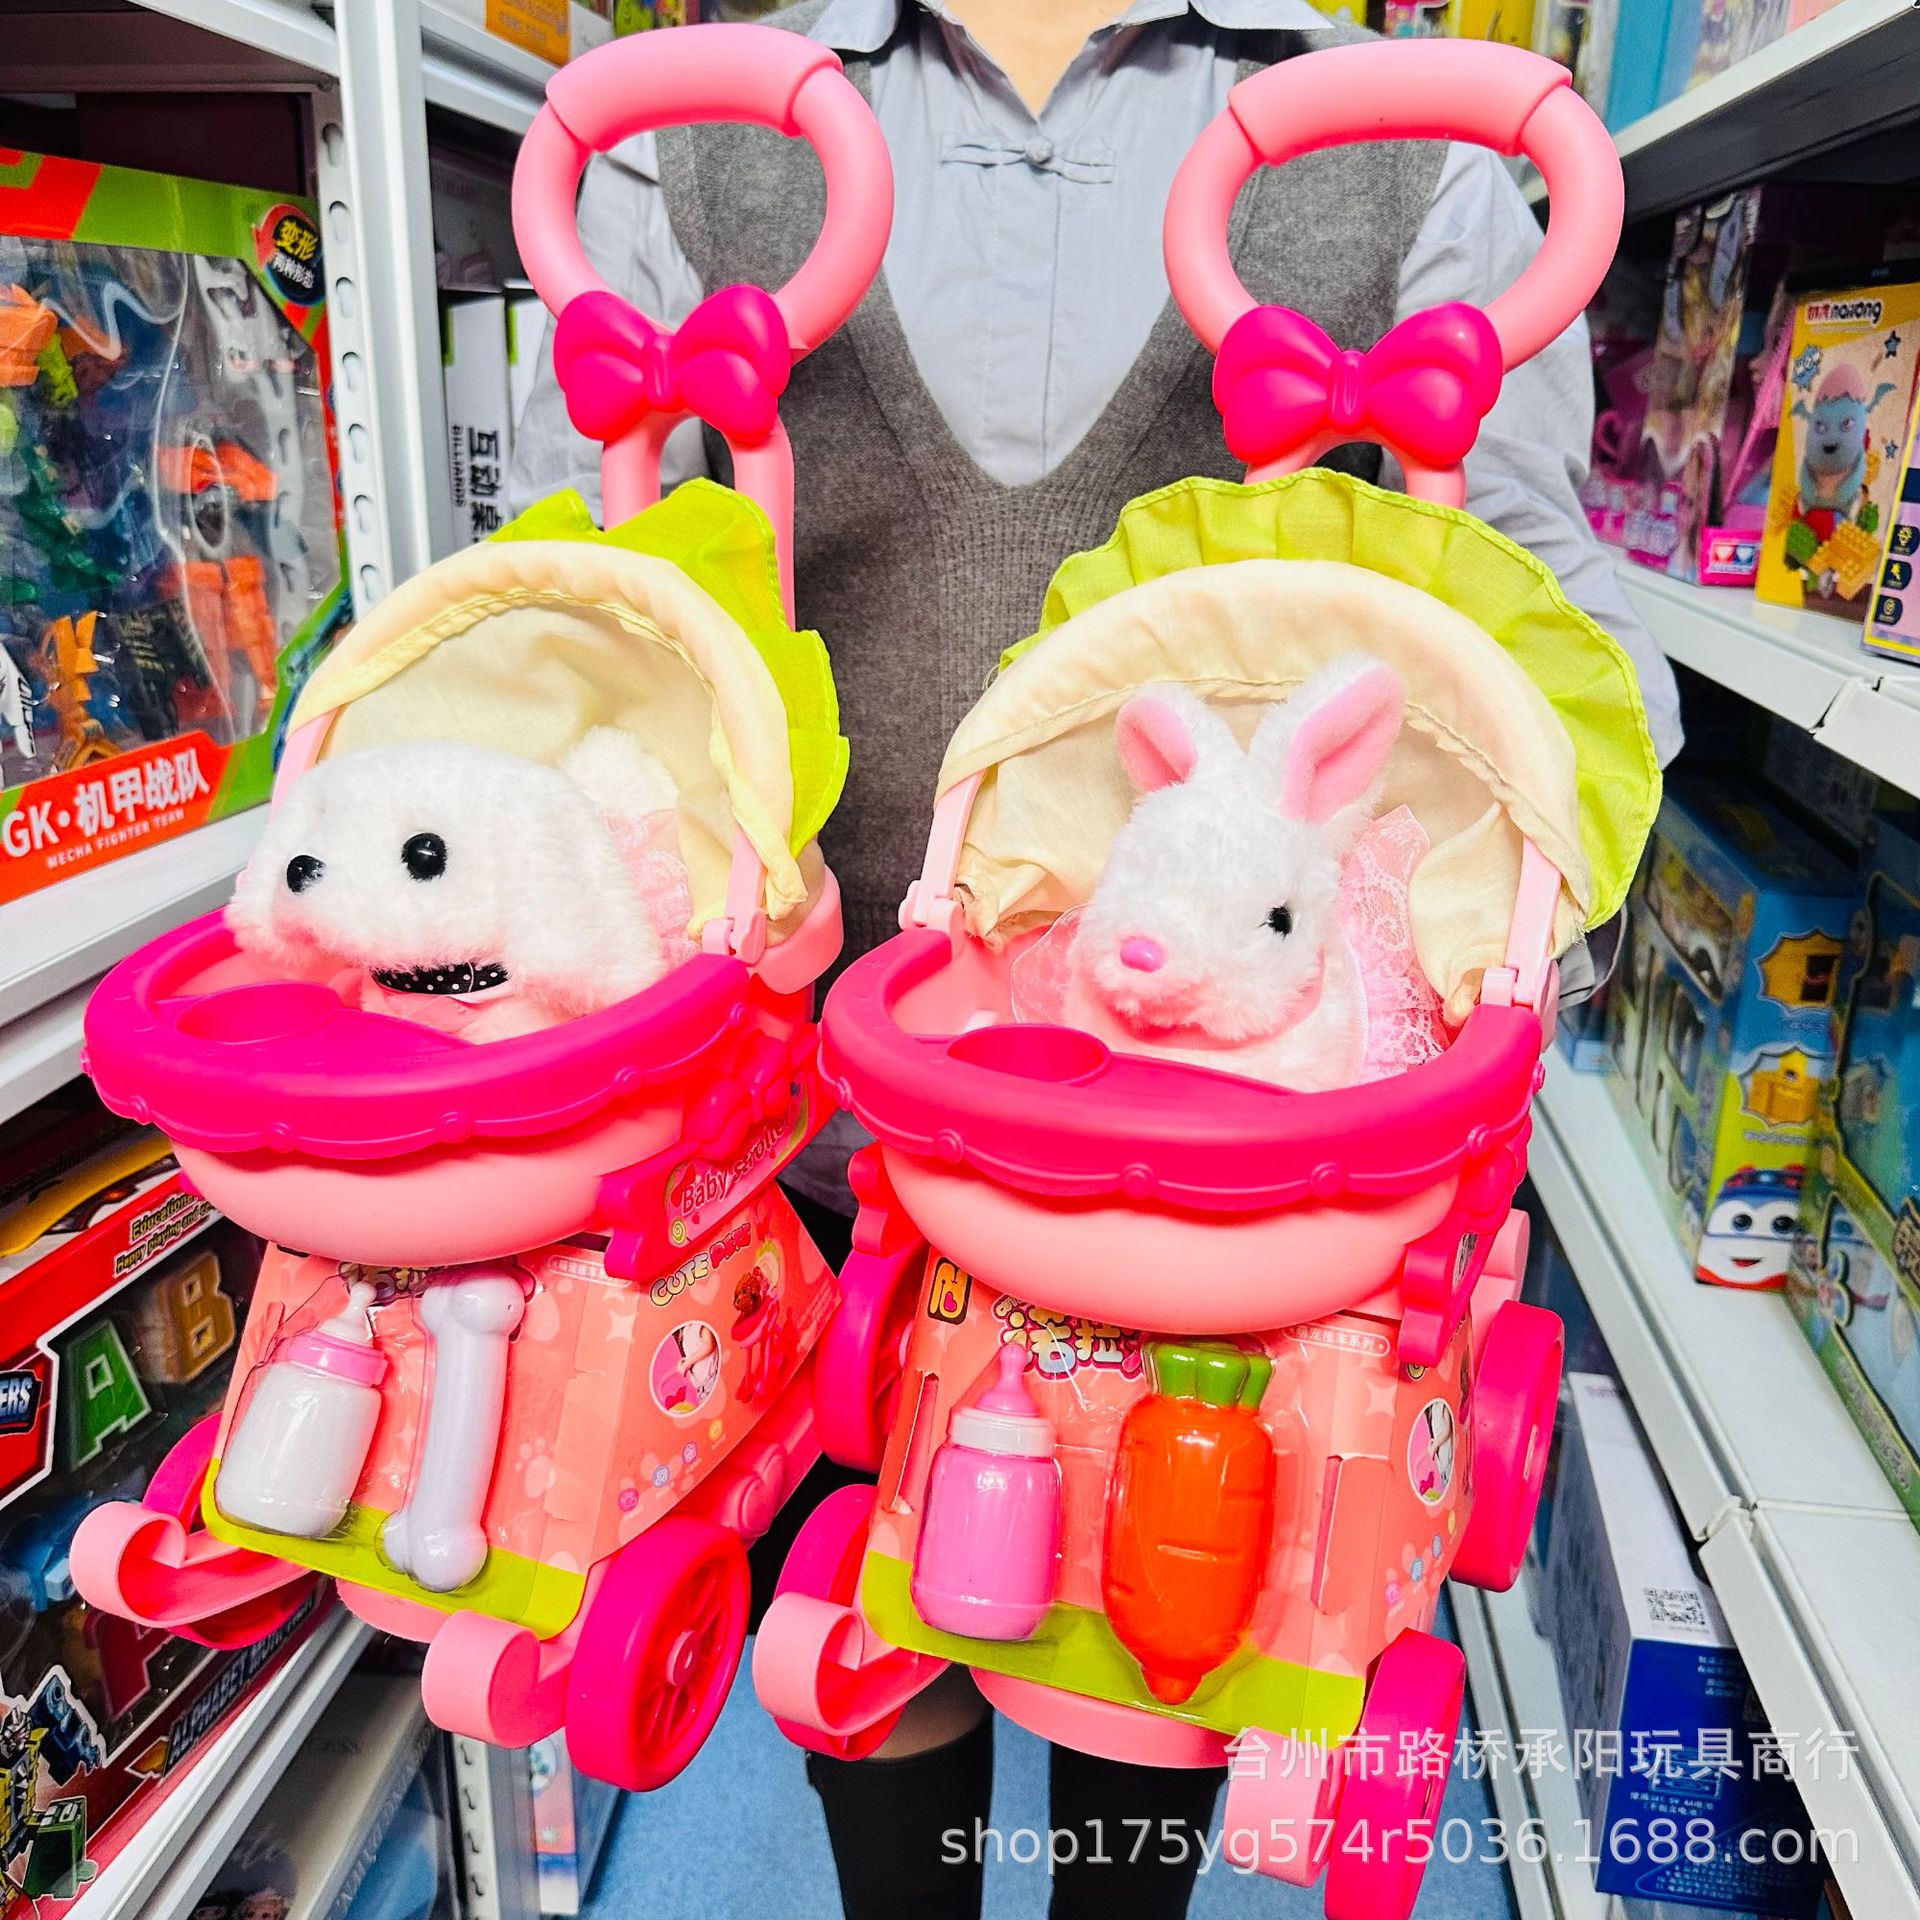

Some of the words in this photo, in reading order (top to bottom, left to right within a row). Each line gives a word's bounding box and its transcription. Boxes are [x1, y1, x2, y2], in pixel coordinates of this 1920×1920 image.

[277, 220, 318, 260] 变形
[47, 844, 93, 869] MECHA
[96, 820, 151, 850] FIGHTER
[154, 808, 186, 830] TEAM
[682, 1167, 728, 1217] Baby
[116, 1243, 146, 1275] Happy
[146, 1223, 181, 1256] playing
[650, 1251, 709, 1307] CUTE
[167, 1648, 250, 1765] ALPHABET
